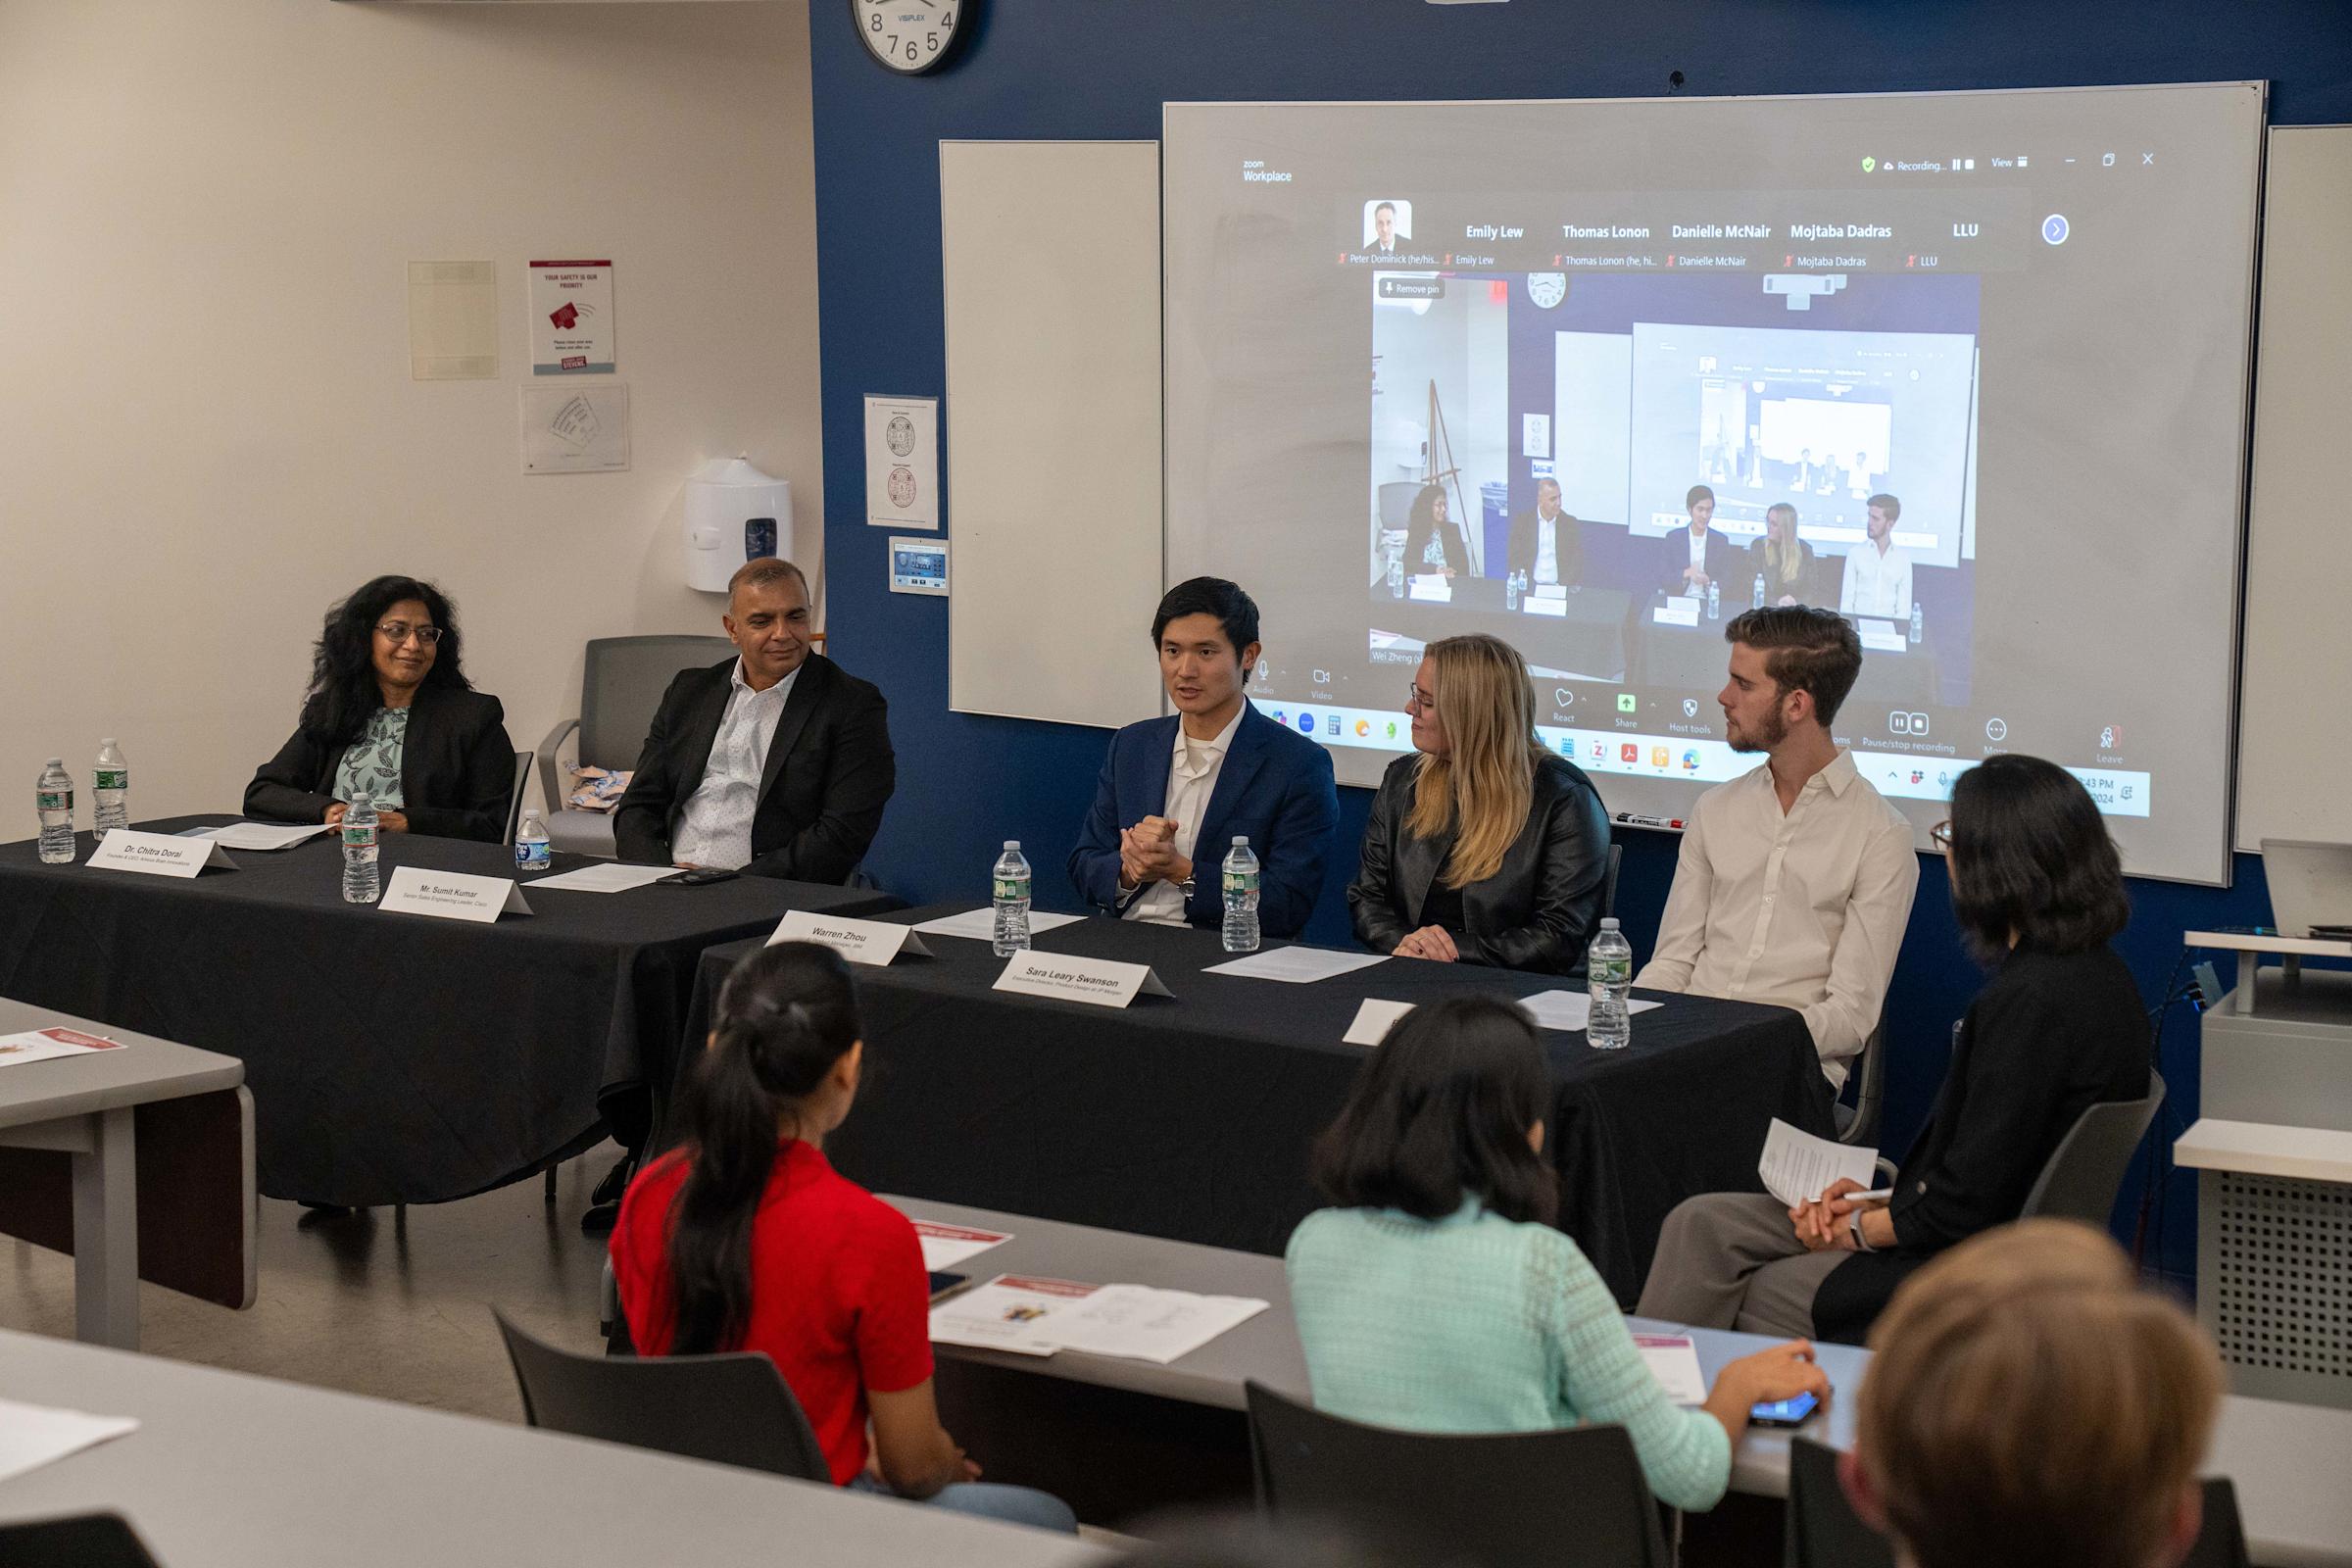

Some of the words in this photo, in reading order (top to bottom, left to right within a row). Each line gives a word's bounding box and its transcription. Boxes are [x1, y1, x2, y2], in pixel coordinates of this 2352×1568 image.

[871, 13, 882, 31] 8
[941, 12, 954, 30] 4
[887, 35, 899, 54] 7
[927, 32, 938, 51] 5
[906, 41, 917, 60] 6
[1243, 160, 1264, 169] zoom
[1991, 157, 2013, 168] View
[1243, 171, 1293, 184] Workplace
[1466, 224, 1498, 241] Emily
[1500, 225, 1524, 239] Lew
[1562, 225, 1609, 238] Thomas
[1612, 225, 1649, 238] Lonon
[1672, 224, 1723, 238] Danielle
[1725, 224, 1772, 238] McNair
[1790, 224, 1844, 241] Mojtaba
[1846, 224, 1892, 238] Dadras
[1953, 223, 1979, 237] LLU
[1349, 254, 1370, 264] Peter
[1371, 253, 1406, 264] Dominick
[1455, 255, 1477, 267] Emily
[1478, 255, 1494, 266] Lew
[1566, 255, 1597, 267] Thomas
[1598, 256, 1625, 267] Lonon
[1626, 256, 1642, 268] (he,
[1679, 256, 1714, 267] Danielle
[1715, 256, 1746, 267] McNair
[1797, 256, 1834, 269] Mojtaba
[1835, 256, 1867, 267] Dadras
[1921, 256, 1938, 267] LLU
[1396, 284, 1427, 295] Remove
[1428, 284, 1440, 297] pin
[1372, 651, 1387, 661] Wei
[1389, 652, 1413, 664] Zheng
[1253, 686, 1274, 695] Audio
[1311, 691, 1333, 700] Video
[1552, 712, 1575, 723] React
[1615, 718, 1638, 729] Share
[1669, 723, 1689, 733] Host
[1690, 724, 1711, 735] tools
[1862, 737, 1911, 751] Pause/stop
[1912, 743, 1956, 755] recording
[2096, 754, 2125, 764] Leave
[2099, 779, 2114, 789] PM
[124, 845, 135, 854] Dr.
[137, 846, 160, 856] Chitra
[432, 886, 454, 896] Sumit
[454, 889, 478, 898] Kumar
[812, 927, 843, 939] Warren
[844, 932, 867, 942] Zhou
[1026, 966, 1048, 978] Sara
[1049, 970, 1075, 982] Leary
[1076, 973, 1119, 988] Swanson
